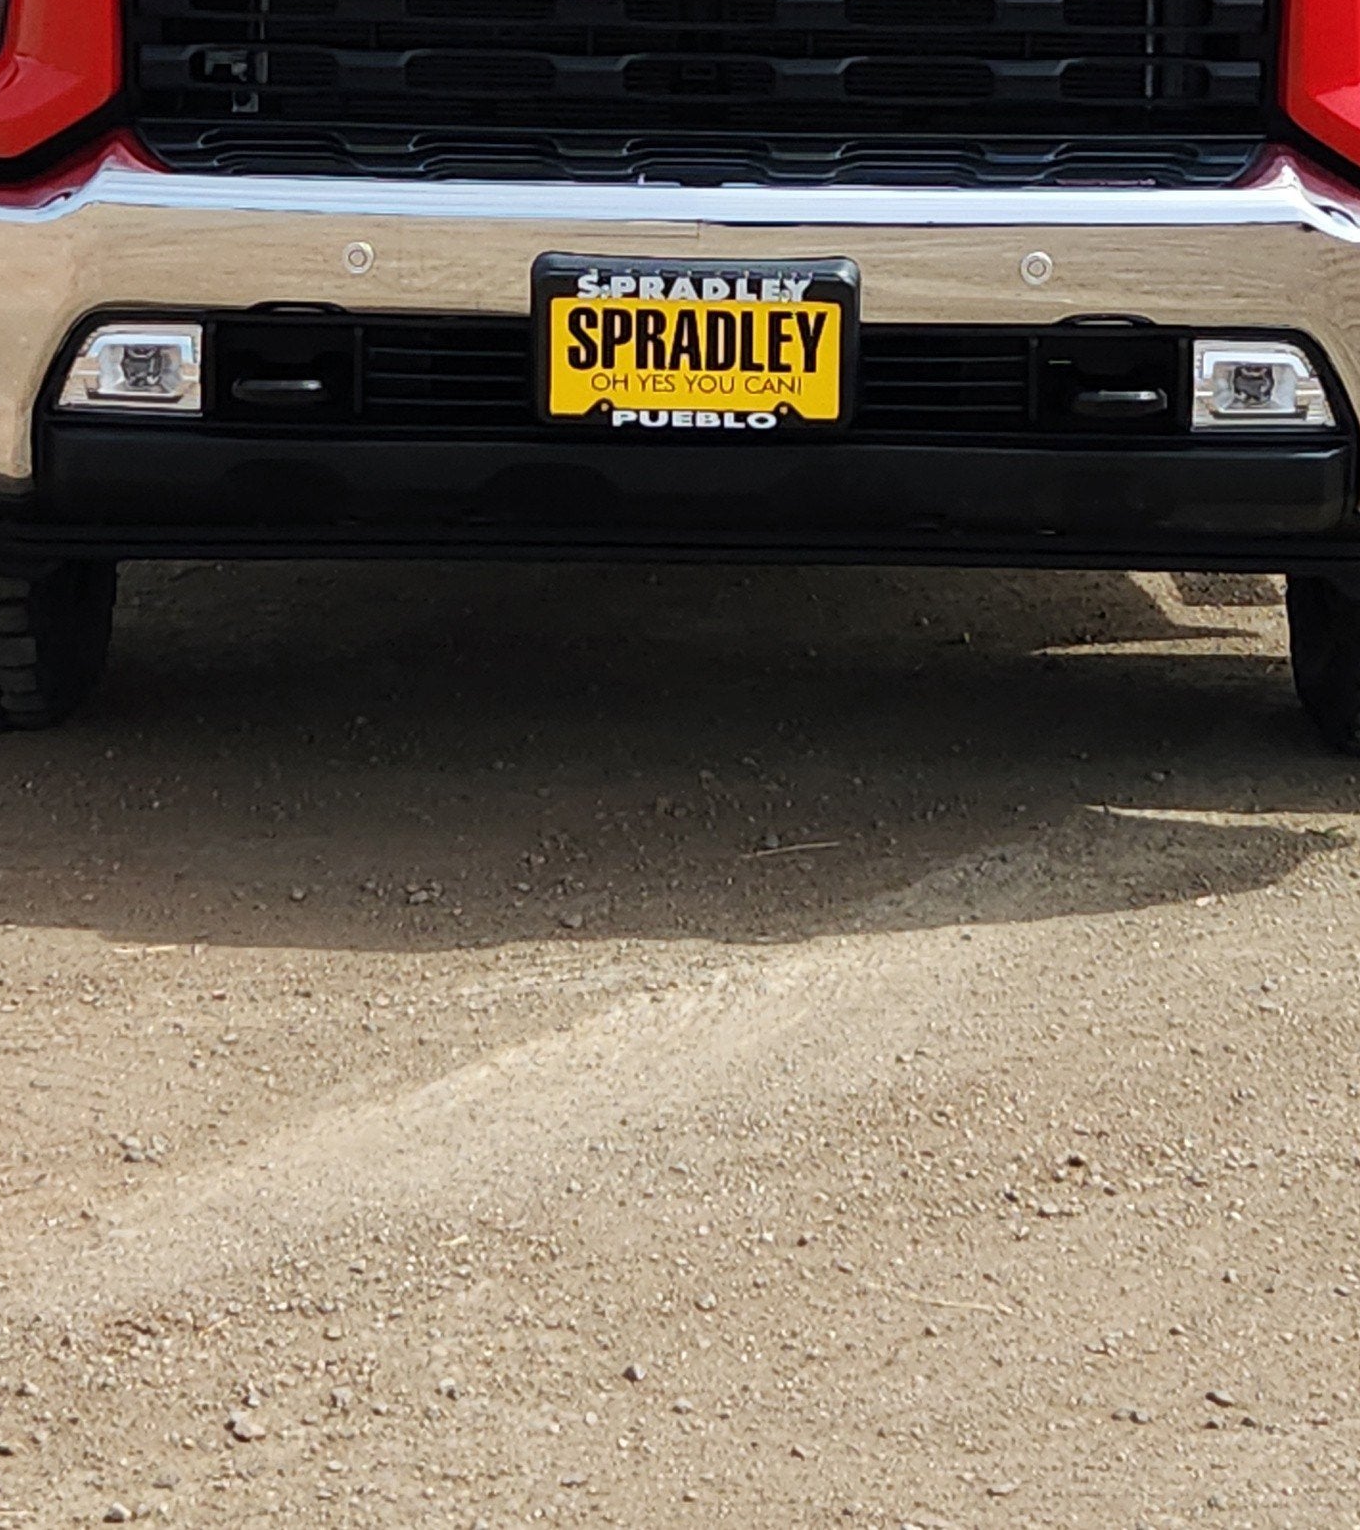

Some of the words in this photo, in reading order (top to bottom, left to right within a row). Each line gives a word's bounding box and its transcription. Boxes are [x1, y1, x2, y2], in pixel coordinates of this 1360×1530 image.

[576, 271, 813, 303] SPRADLEY
[566, 306, 828, 373] SPRADLEY
[591, 372, 629, 392] OH
[640, 372, 676, 393] YES
[683, 373, 735, 395] YOU
[612, 409, 778, 430] PUEBLO
